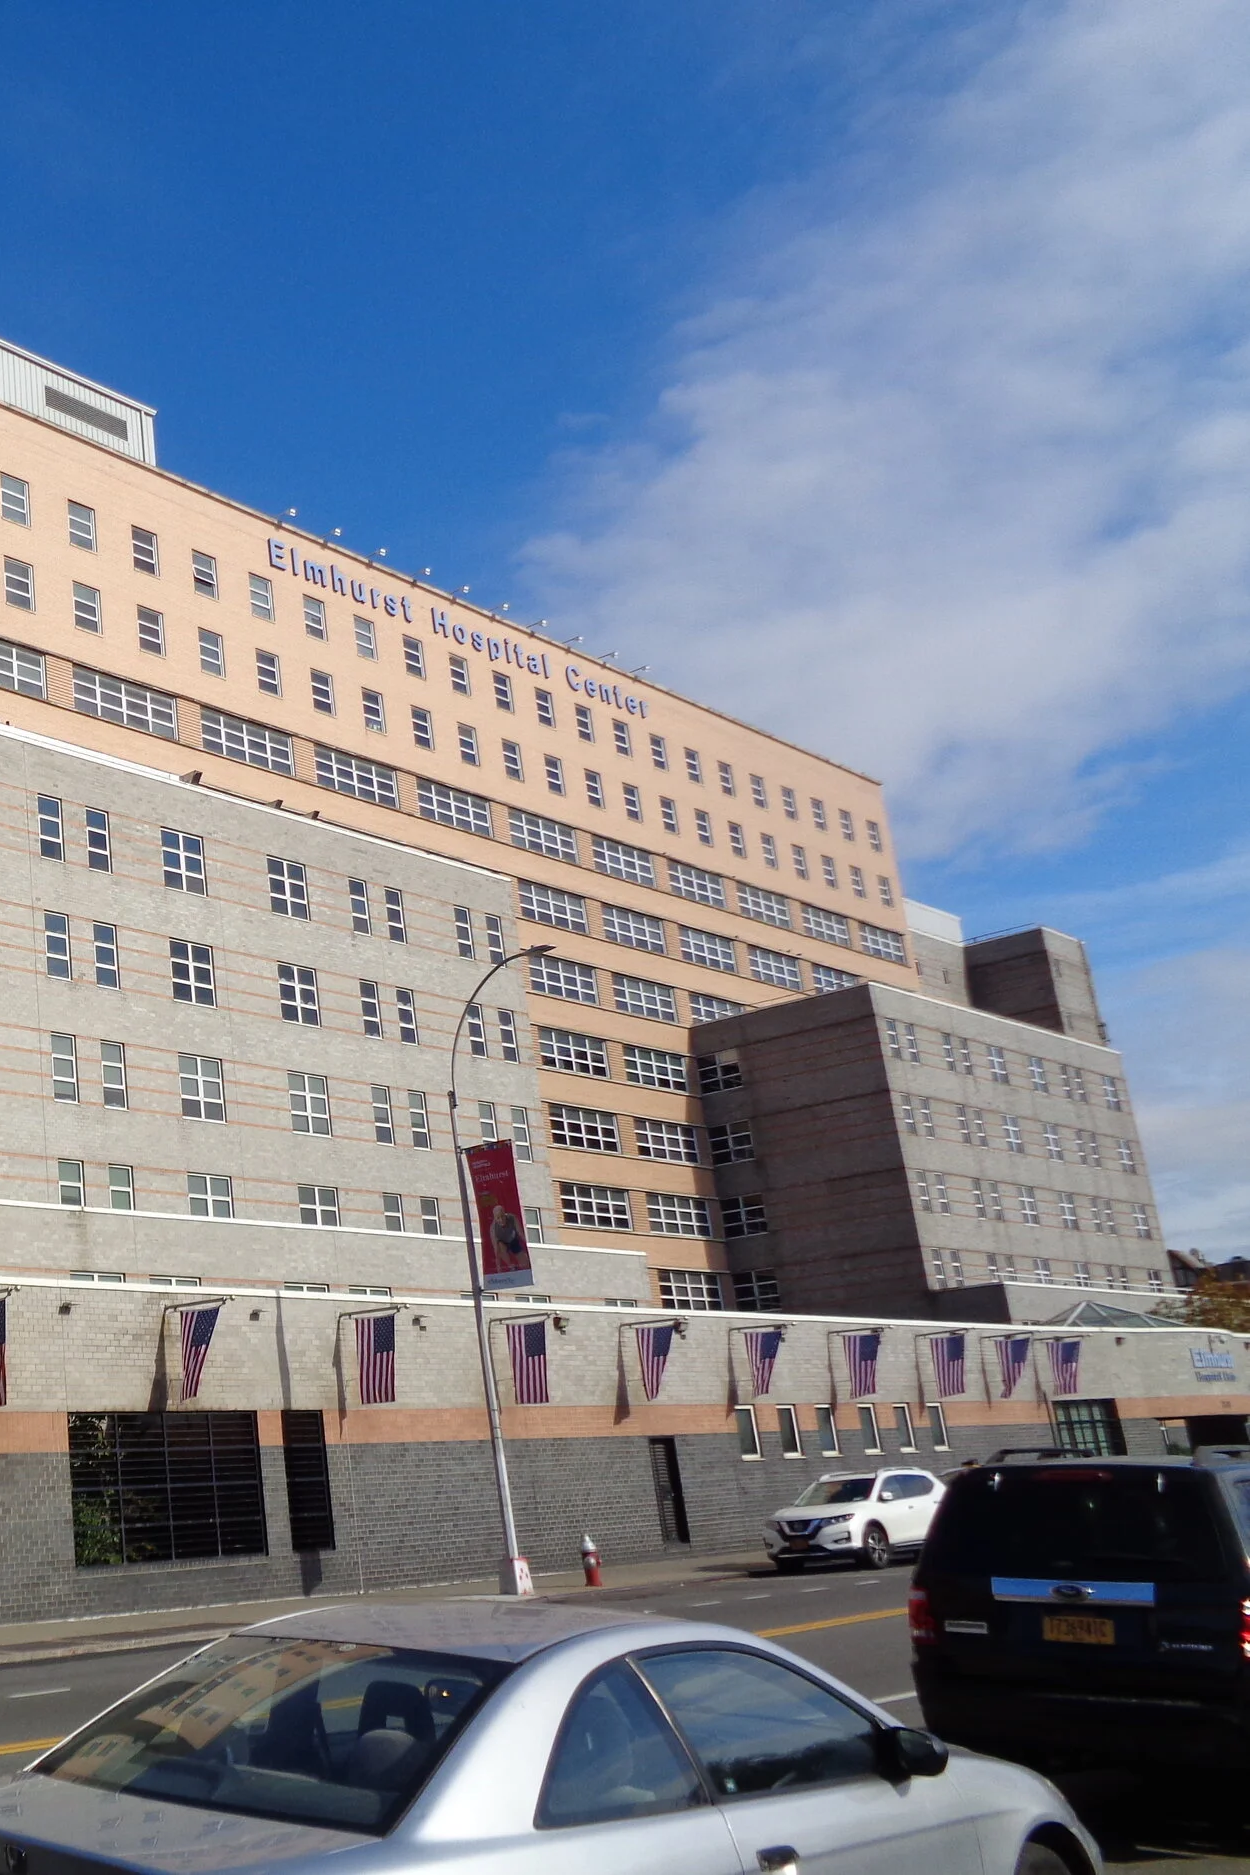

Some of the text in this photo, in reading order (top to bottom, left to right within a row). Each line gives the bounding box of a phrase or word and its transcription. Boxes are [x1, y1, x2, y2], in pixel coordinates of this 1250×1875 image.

[267, 537, 649, 718] Elmhurst Hospital Center
